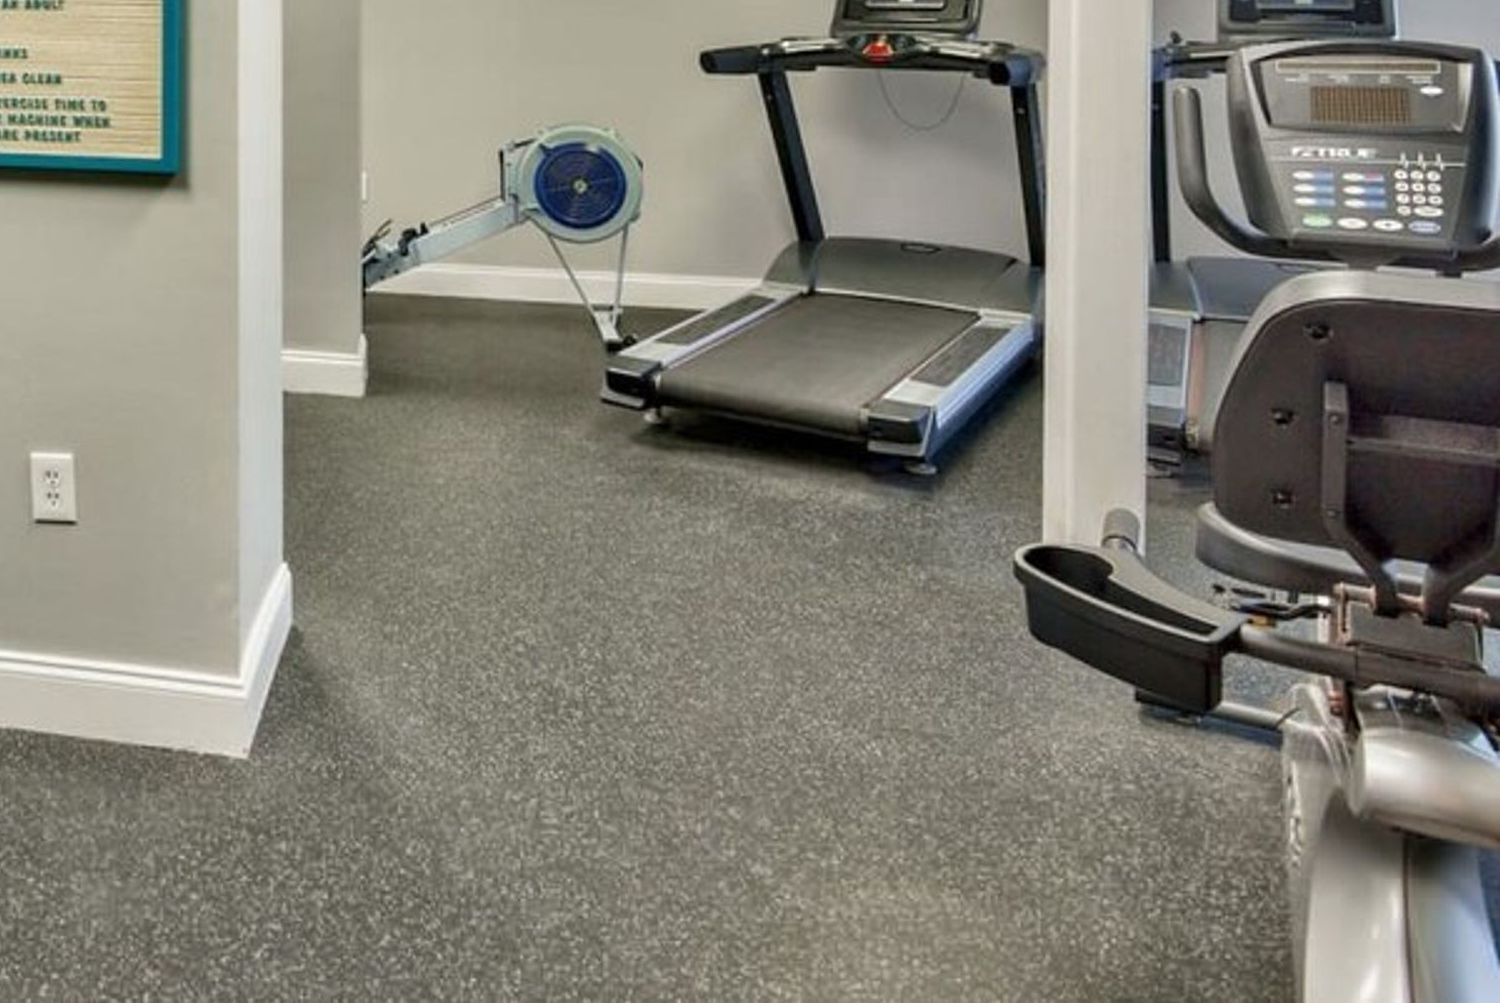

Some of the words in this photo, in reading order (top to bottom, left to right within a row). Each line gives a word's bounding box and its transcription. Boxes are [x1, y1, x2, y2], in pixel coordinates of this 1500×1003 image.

[25, 0, 65, 11] ADULT
[22, 73, 62, 85] CLEAN
[54, 99, 85, 111] TIME
[90, 100, 107, 112] TO
[8, 114, 67, 127] MACHINE
[73, 116, 112, 129] WHEN
[24, 131, 82, 143] PRESENT
